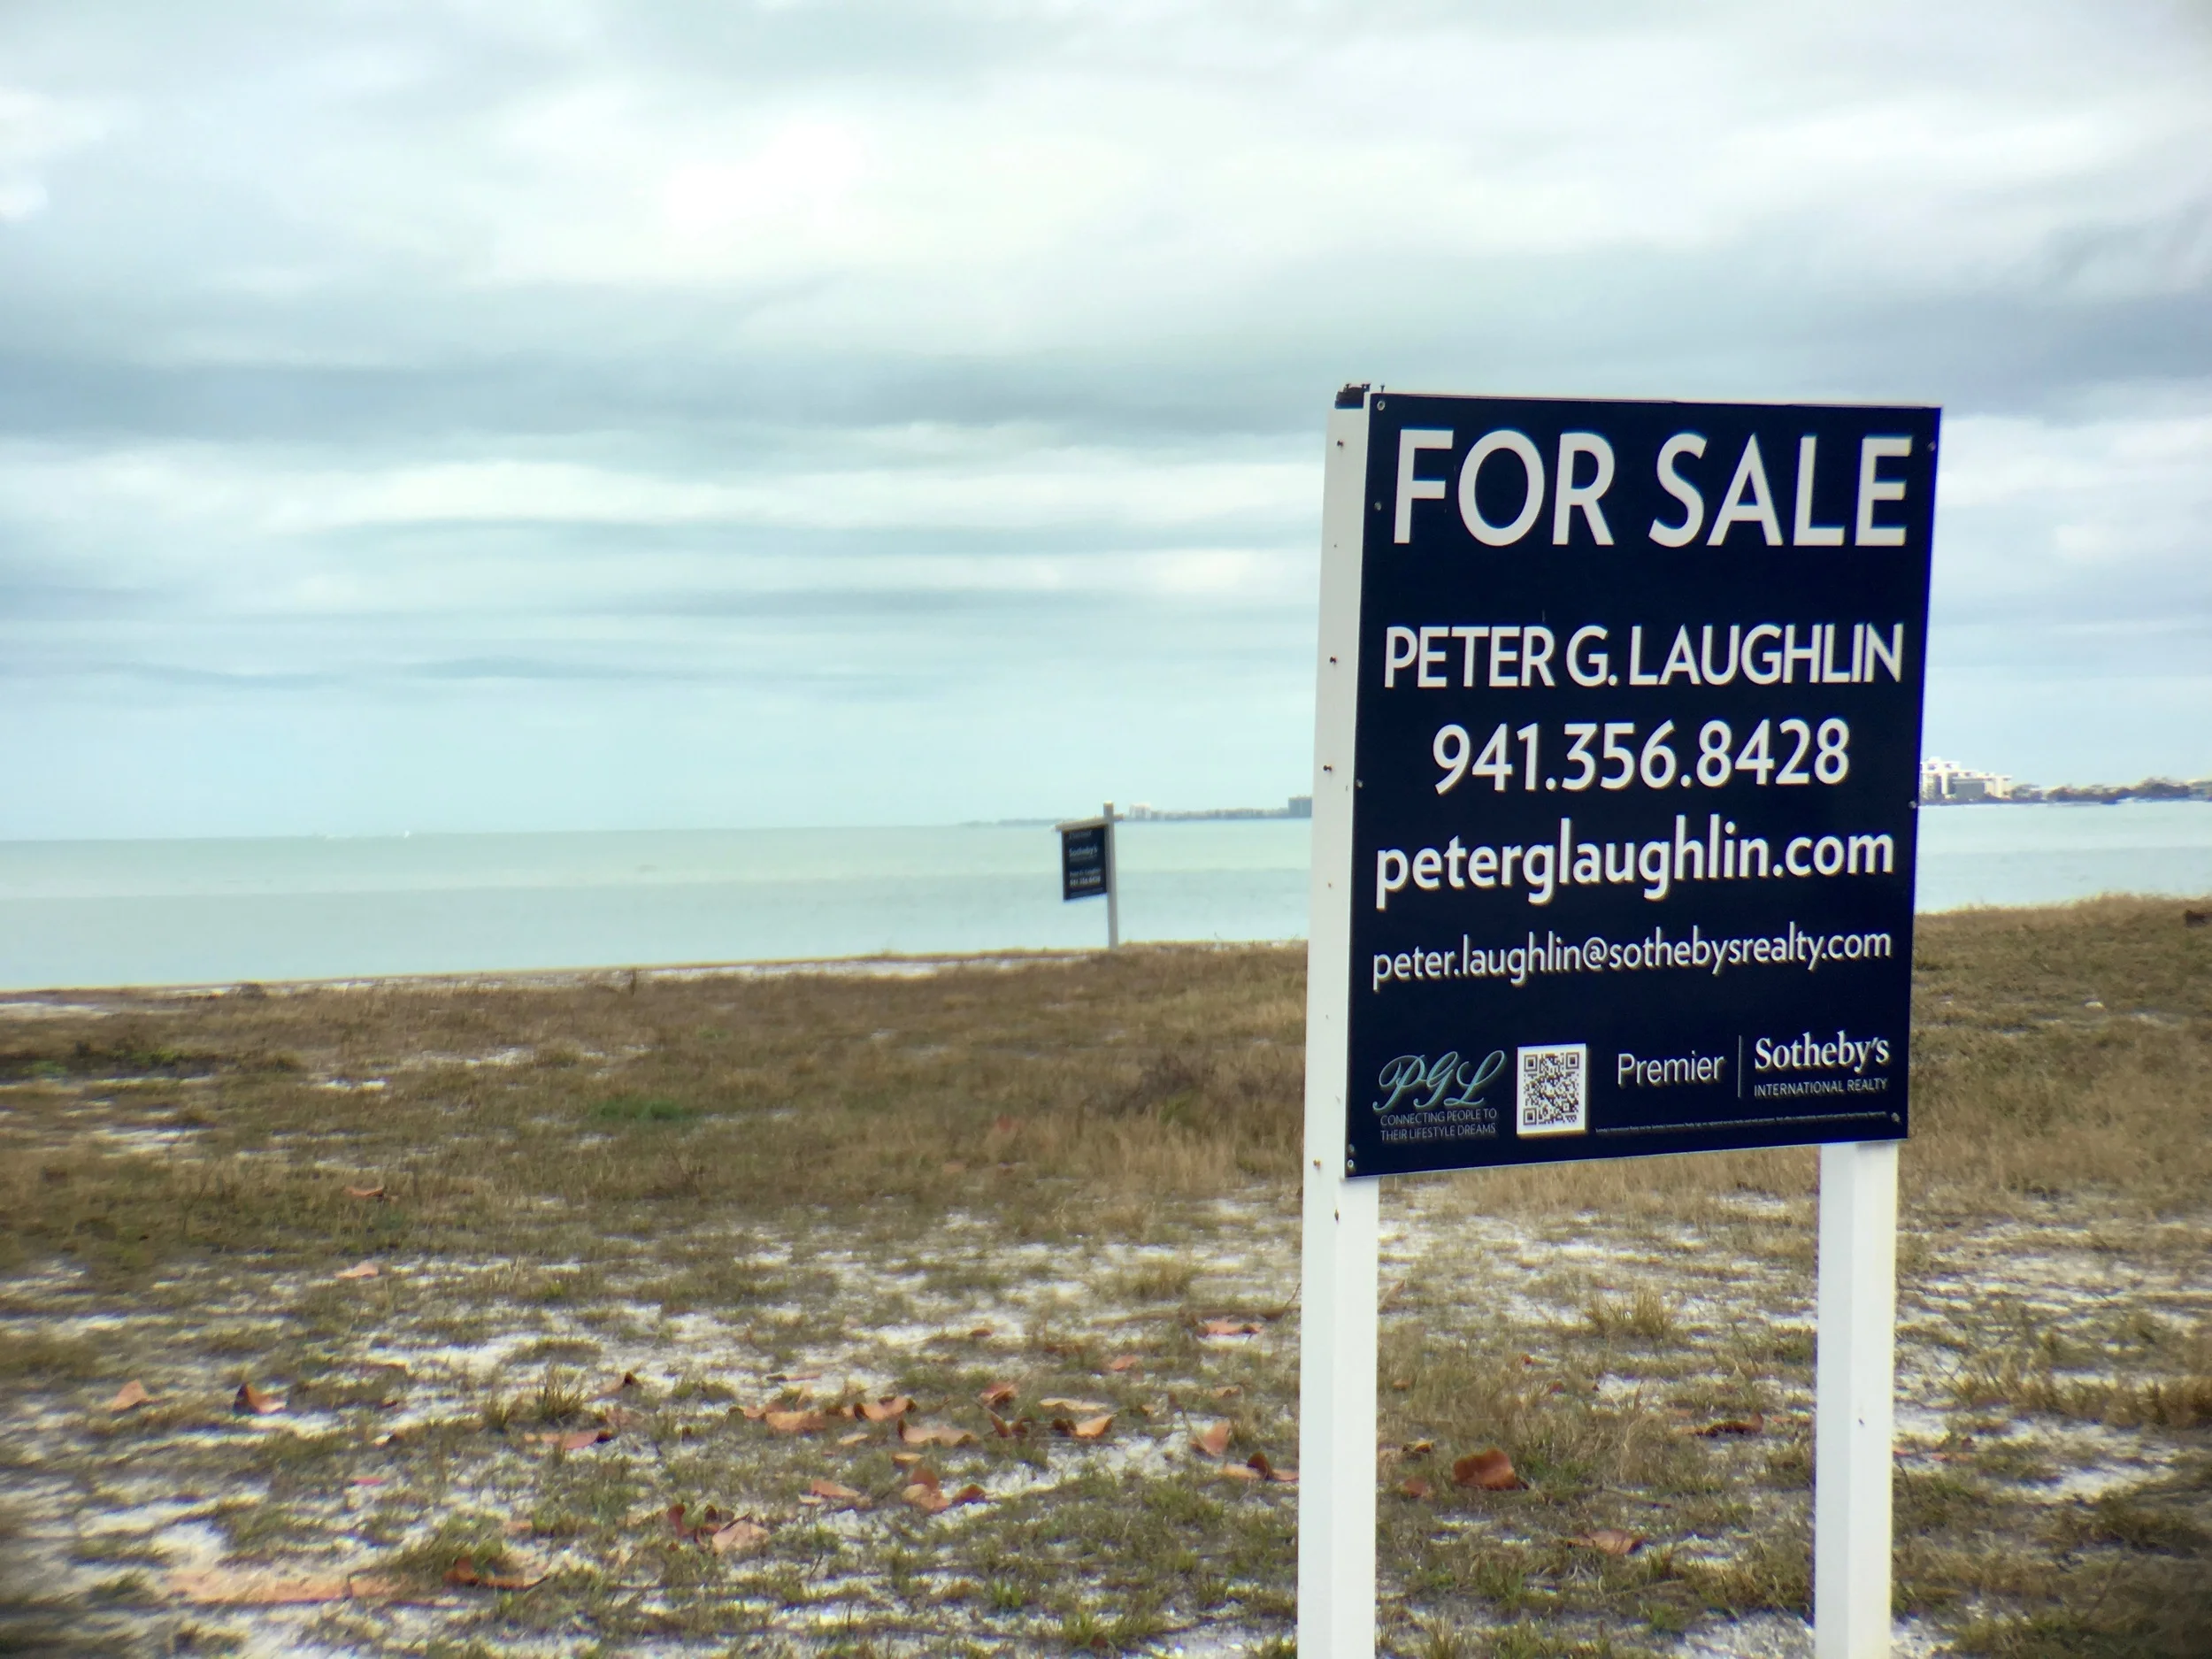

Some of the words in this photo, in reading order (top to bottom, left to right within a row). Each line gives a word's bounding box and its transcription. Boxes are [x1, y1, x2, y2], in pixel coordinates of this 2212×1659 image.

[1394, 428, 1615, 547] FOR
[1648, 433, 1913, 548] SALE
[1385, 625, 1555, 688] PETER
[1566, 625, 1617, 687] G.
[1630, 623, 1903, 686] LAUGHLIN
[1432, 718, 1850, 795] 941.356.8428
[1376, 814, 1893, 910] peterglaughlin.com
[1373, 921, 1892, 991] peter.laughlin@sothebysrealty.com
[1617, 1050, 1724, 1086] Premier
[1755, 1030, 1890, 1072] Sotheby's
[1755, 1081, 1844, 1097] INTERNATIONAL
[1847, 1078, 1888, 1093] REALTY
[1380, 1110, 1445, 1126] CONNECTING
[1447, 1109, 1481, 1123] PEOPLE
[1483, 1108, 1497, 1119] TO
[1380, 1128, 1408, 1141] THEIR
[1409, 1125, 1455, 1139] LIFESTYLE
[1457, 1122, 1496, 1135] DREAMS
